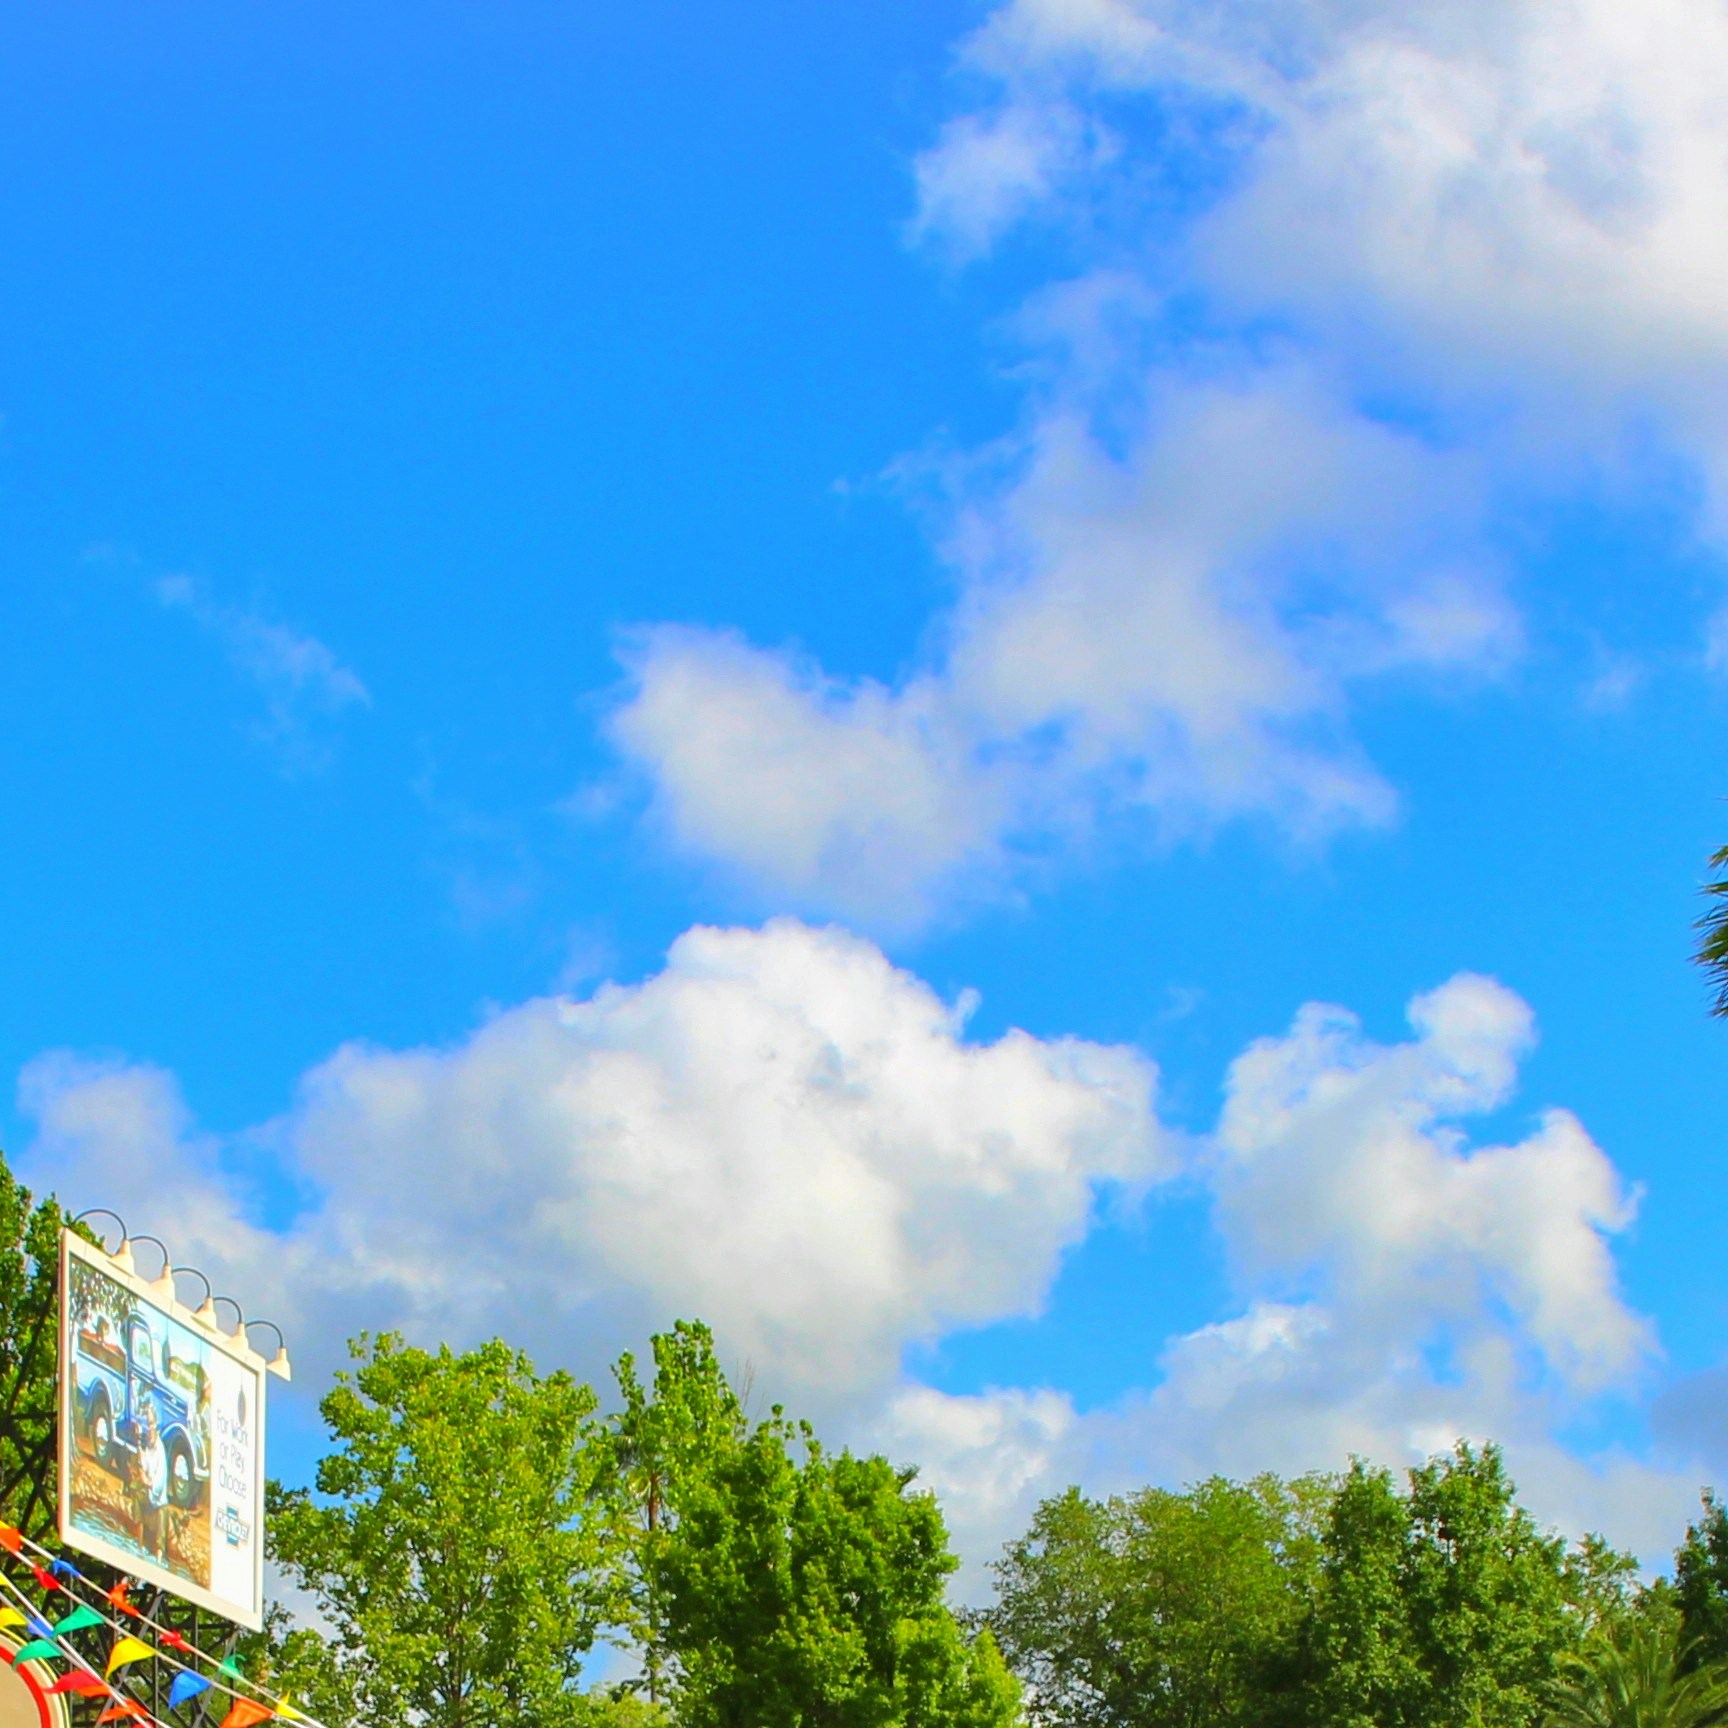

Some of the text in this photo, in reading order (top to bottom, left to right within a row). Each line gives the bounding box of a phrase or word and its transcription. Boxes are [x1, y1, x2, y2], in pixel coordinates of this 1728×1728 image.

[230, 1443, 246, 1475] Play
[218, 1464, 247, 1500] Choose
[215, 1509, 249, 1544] CHEVROLET
